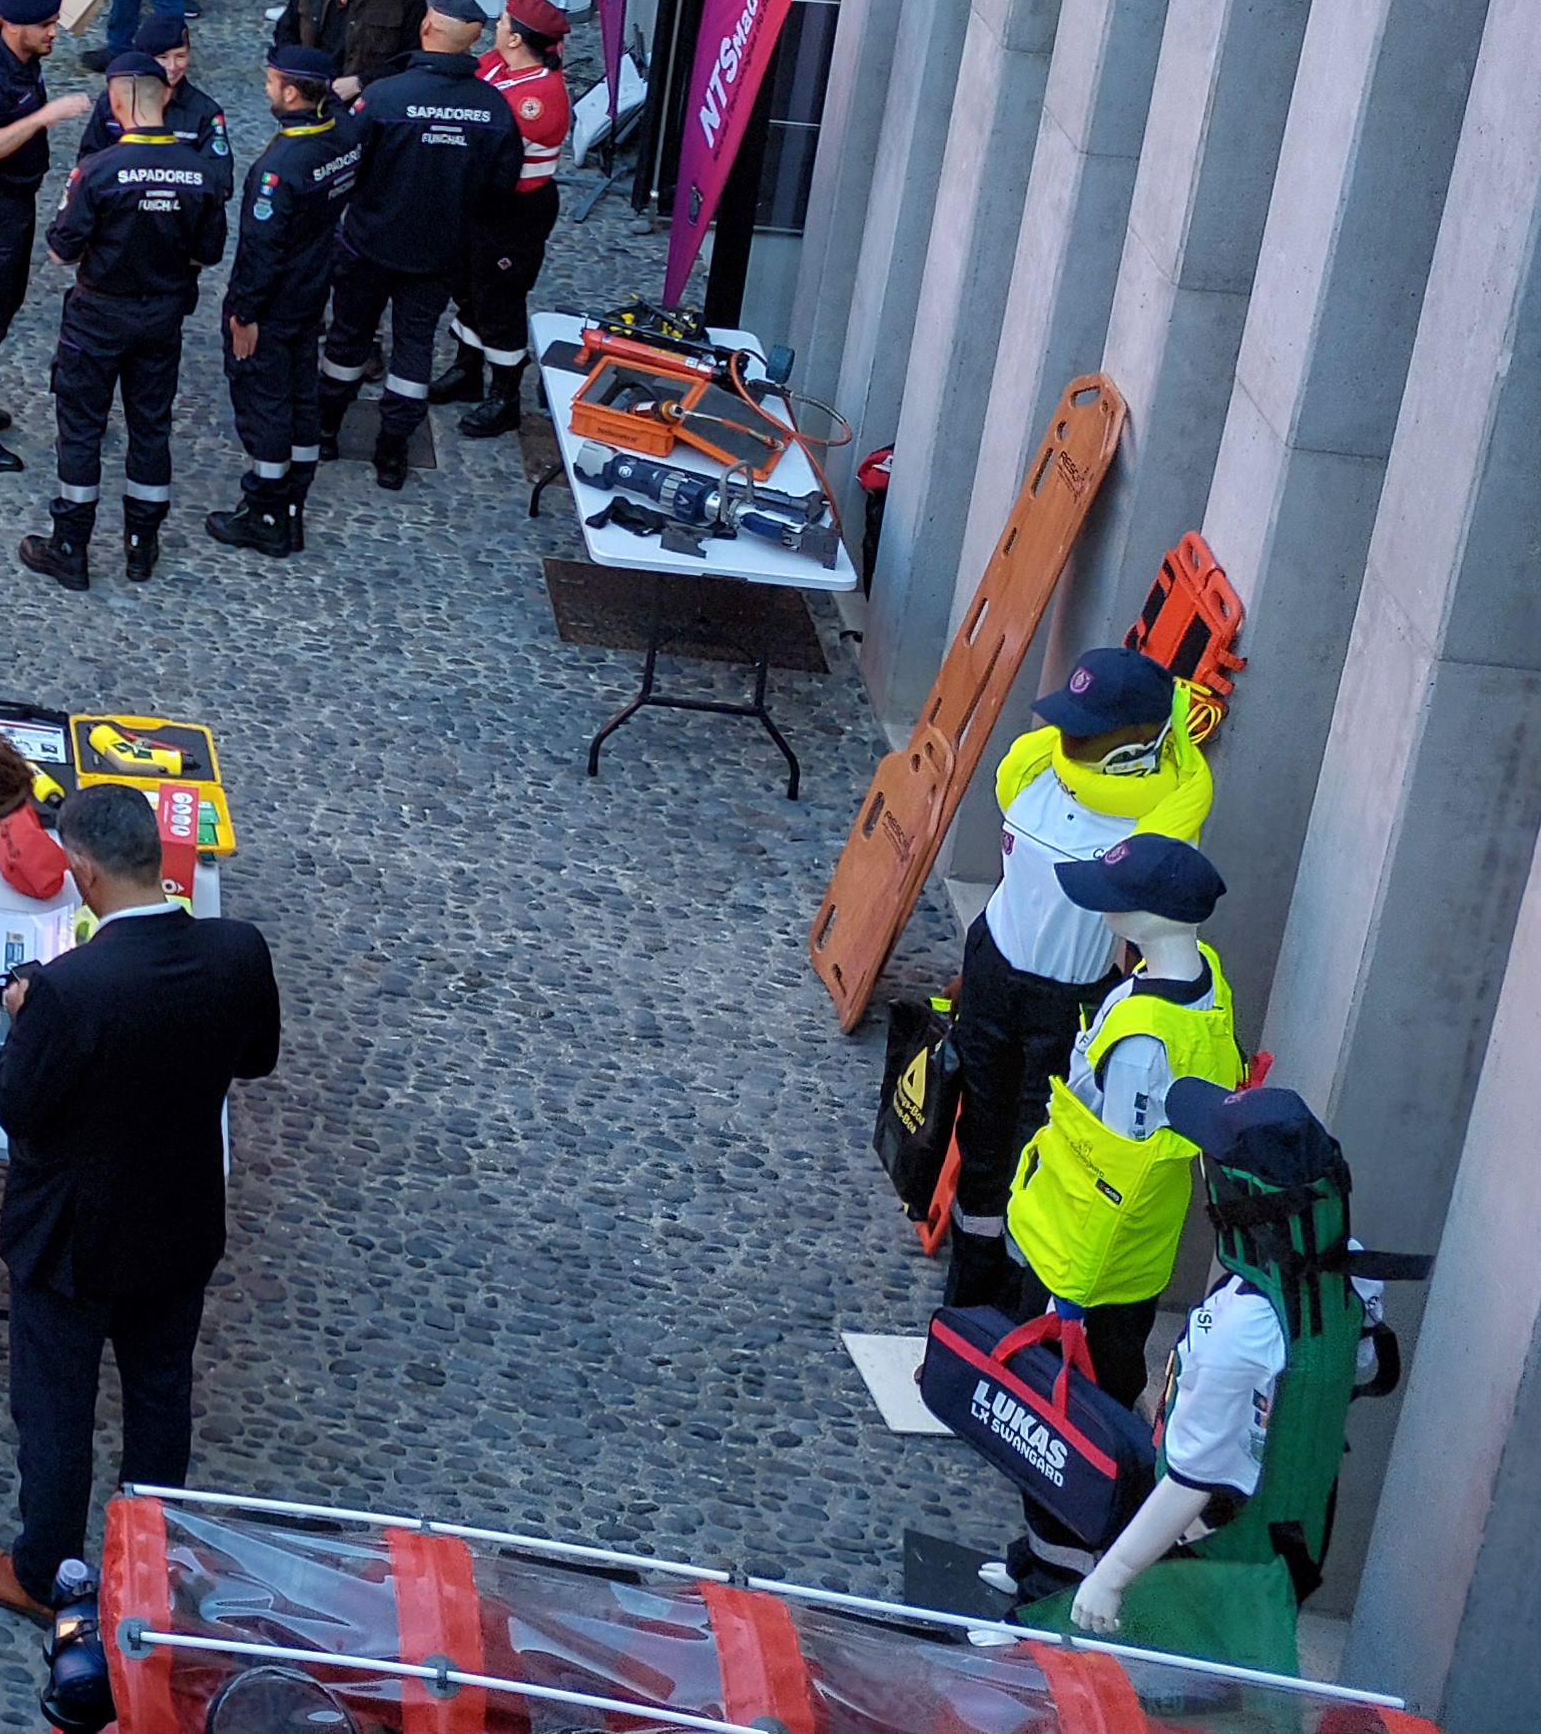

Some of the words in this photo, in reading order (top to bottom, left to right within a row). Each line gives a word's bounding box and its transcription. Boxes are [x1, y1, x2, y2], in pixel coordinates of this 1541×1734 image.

[406, 105, 491, 123] SAPADORES
[118, 169, 203, 186] SAPADORES
[971, 1402, 989, 1425] LX
[990, 1418, 1065, 1487] SWANGARD
[972, 1380, 1067, 1469] LUKAS
